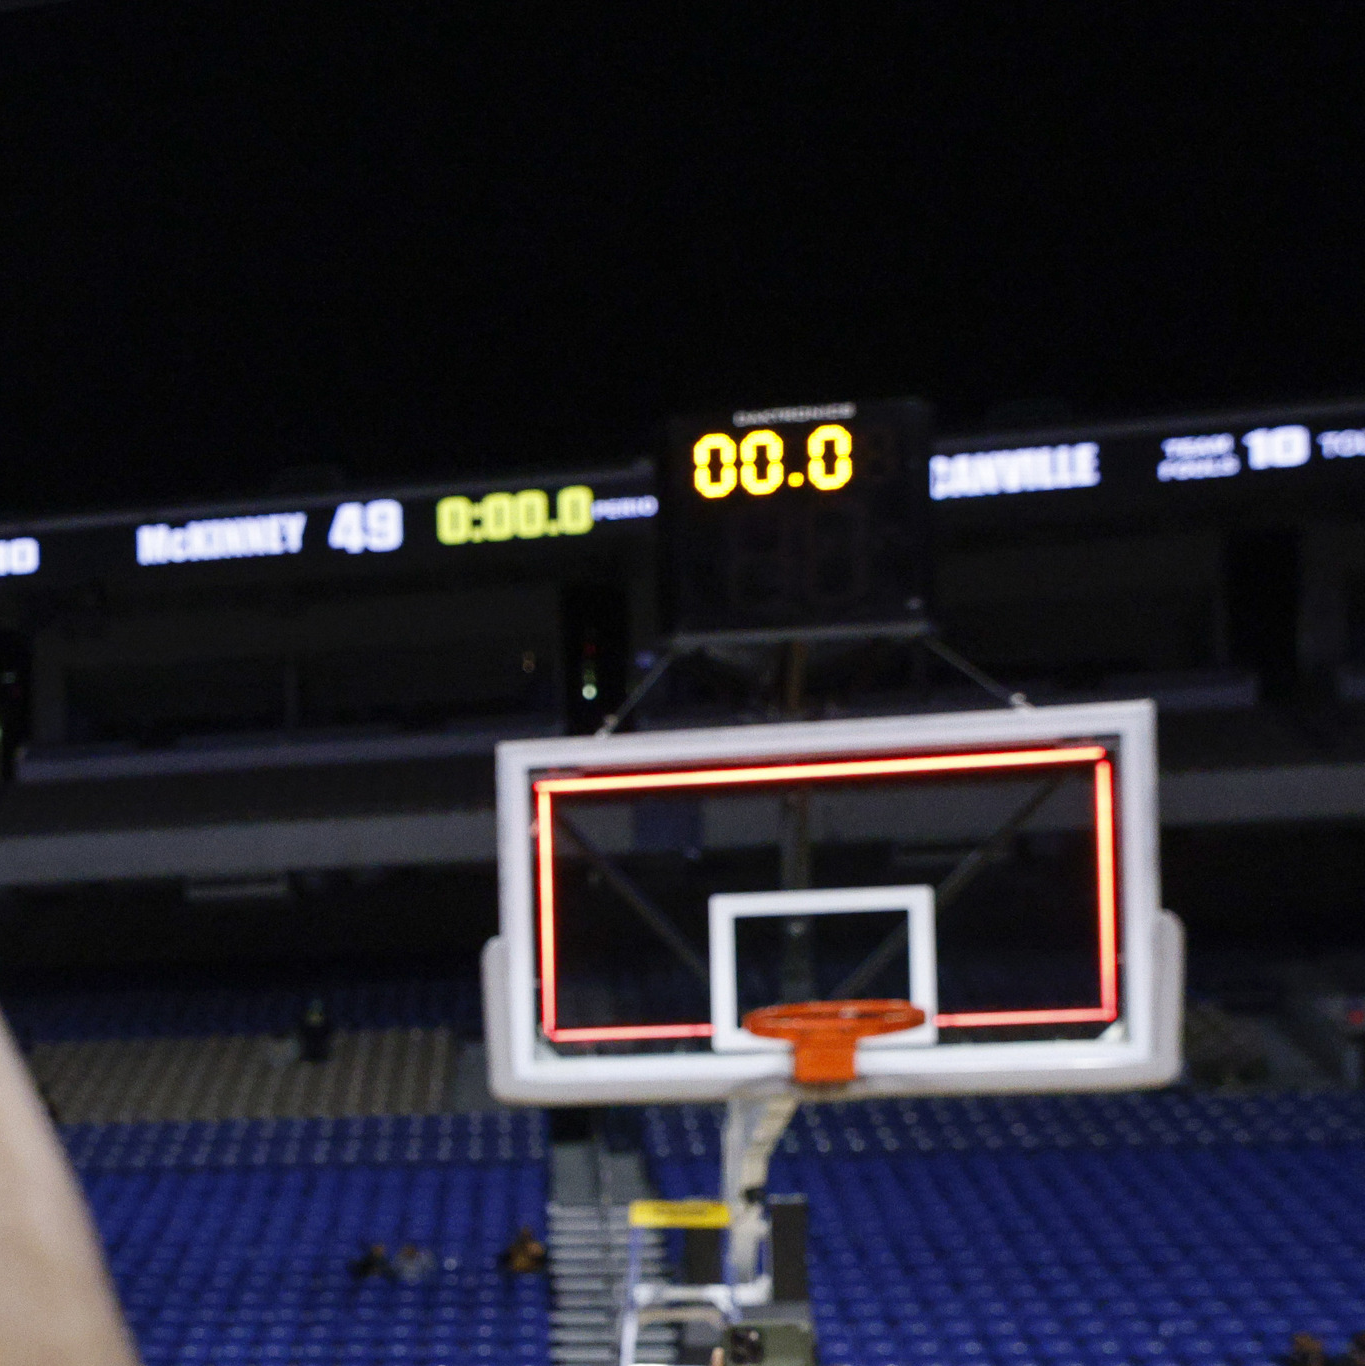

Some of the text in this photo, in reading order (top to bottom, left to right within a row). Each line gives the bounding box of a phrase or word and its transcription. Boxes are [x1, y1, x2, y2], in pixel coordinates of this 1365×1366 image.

[694, 424, 853, 498] 00.0
[1241, 424, 1312, 470] 10
[327, 499, 404, 554] 49
[436, 485, 594, 546] 0:00.0
